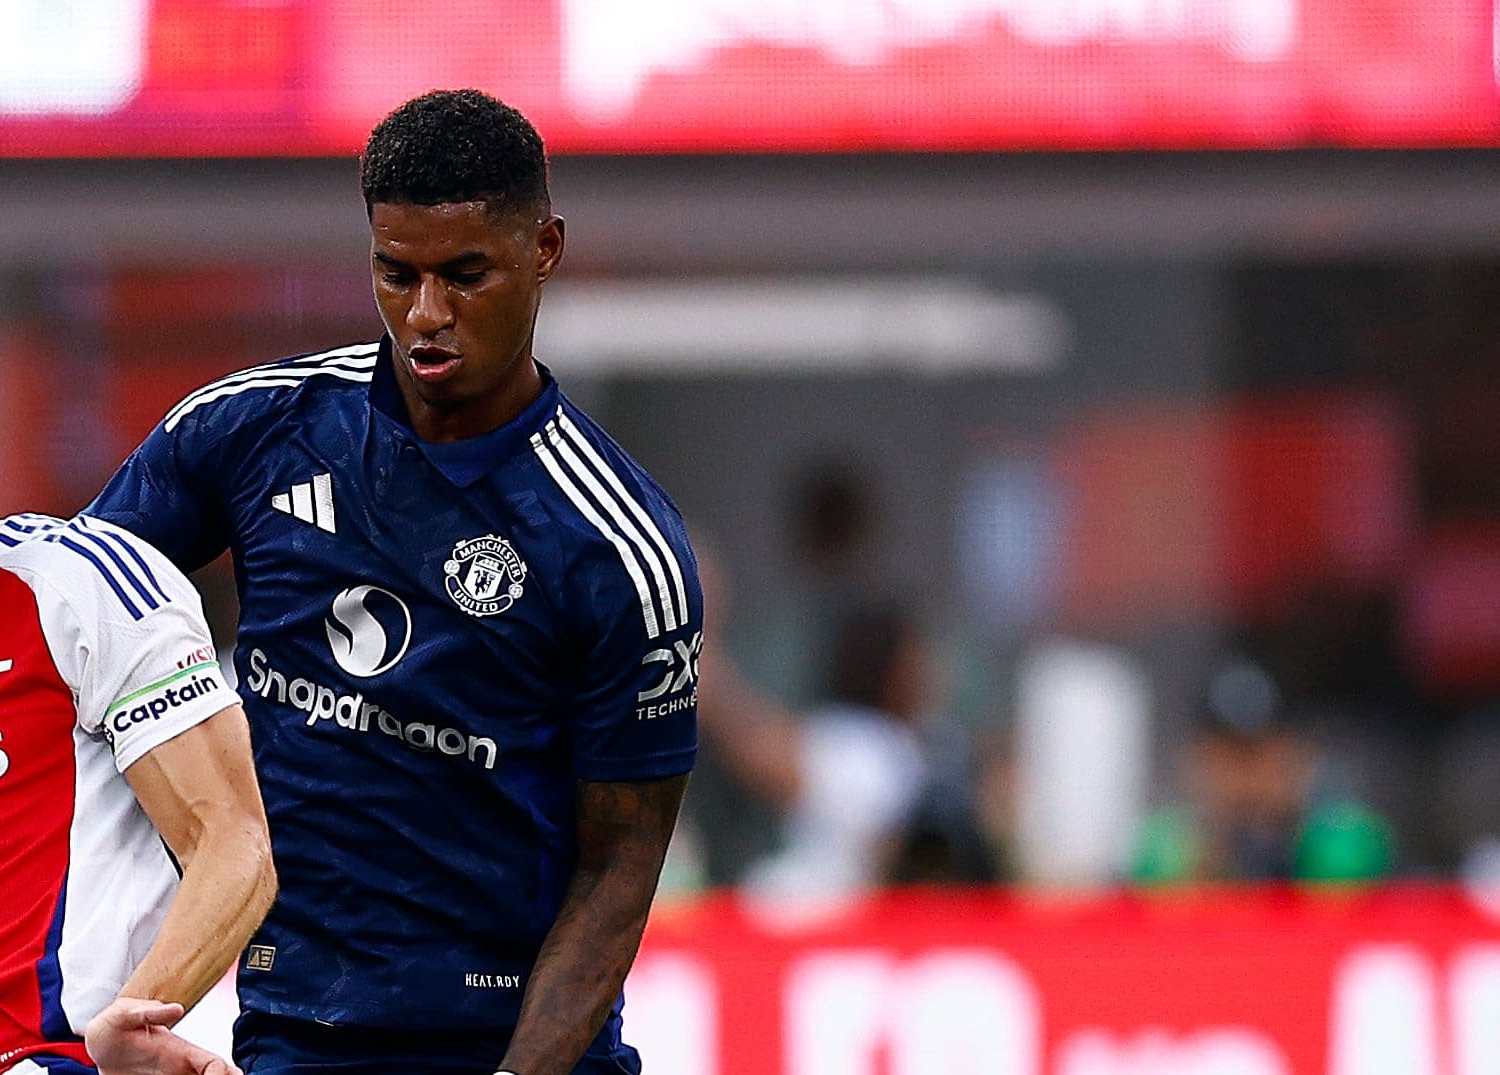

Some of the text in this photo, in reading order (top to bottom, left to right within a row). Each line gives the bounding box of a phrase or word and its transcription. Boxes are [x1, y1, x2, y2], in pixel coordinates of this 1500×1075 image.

[459, 540, 521, 578] MANCHESTER
[453, 589, 499, 612] UNITED
[113, 674, 219, 733] Captain
[246, 647, 498, 770] Snapdragon
[465, 973, 520, 988] HEAT.RDY
